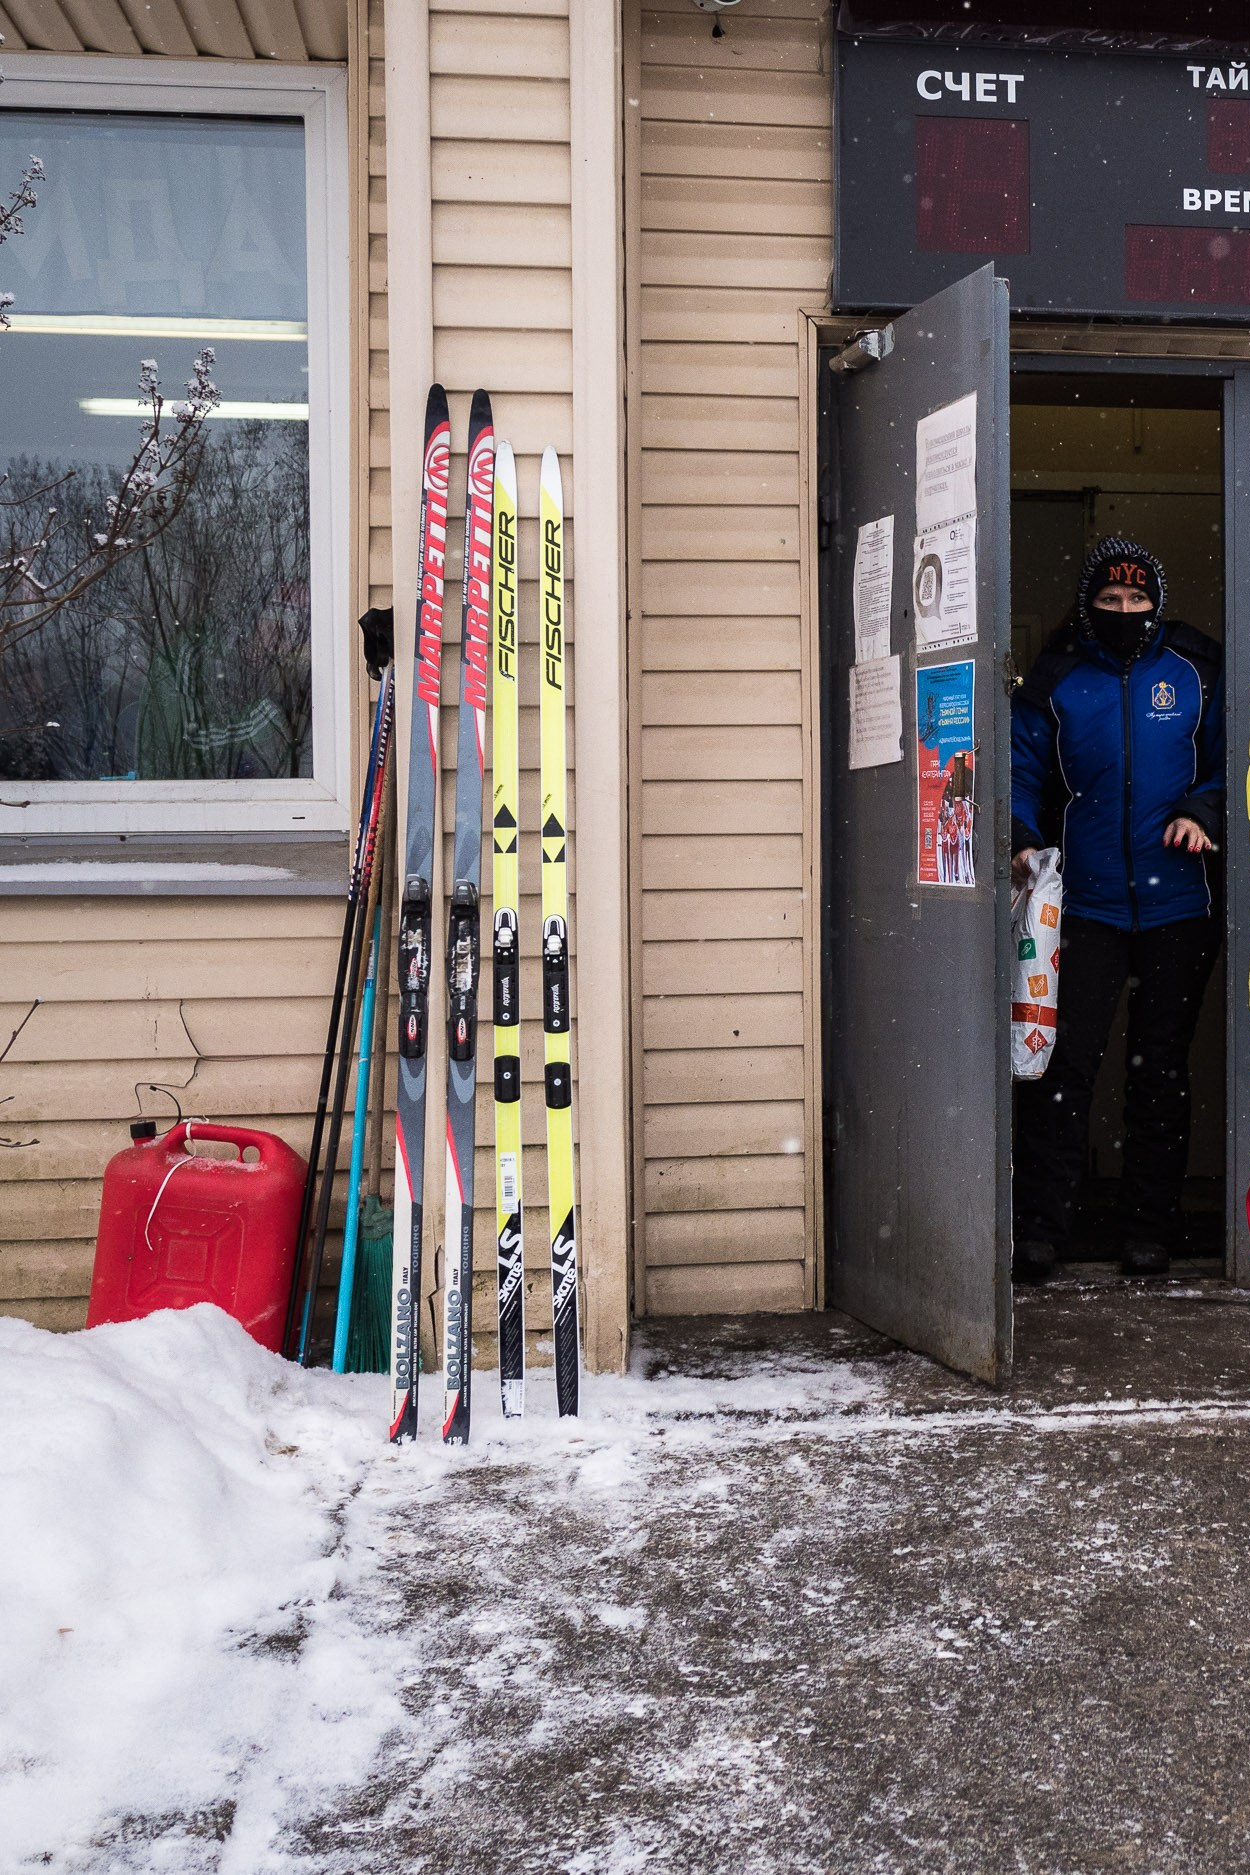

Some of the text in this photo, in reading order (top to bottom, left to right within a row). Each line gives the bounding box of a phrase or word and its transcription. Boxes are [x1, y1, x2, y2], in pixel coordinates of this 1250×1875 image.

[916, 70, 1024, 104] СЧЕТ
[417, 488, 448, 708] MARPETTI
[464, 492, 493, 712] MARPETTI
[498, 510, 515, 682] FISCHER
[546, 519, 562, 690] FISCHER
[1109, 562, 1146, 585] NYC
[498, 1228, 523, 1269] LS
[552, 1234, 576, 1275] LS
[396, 1288, 412, 1390] BOLZANO
[448, 1289, 463, 1390] BOLZANO
